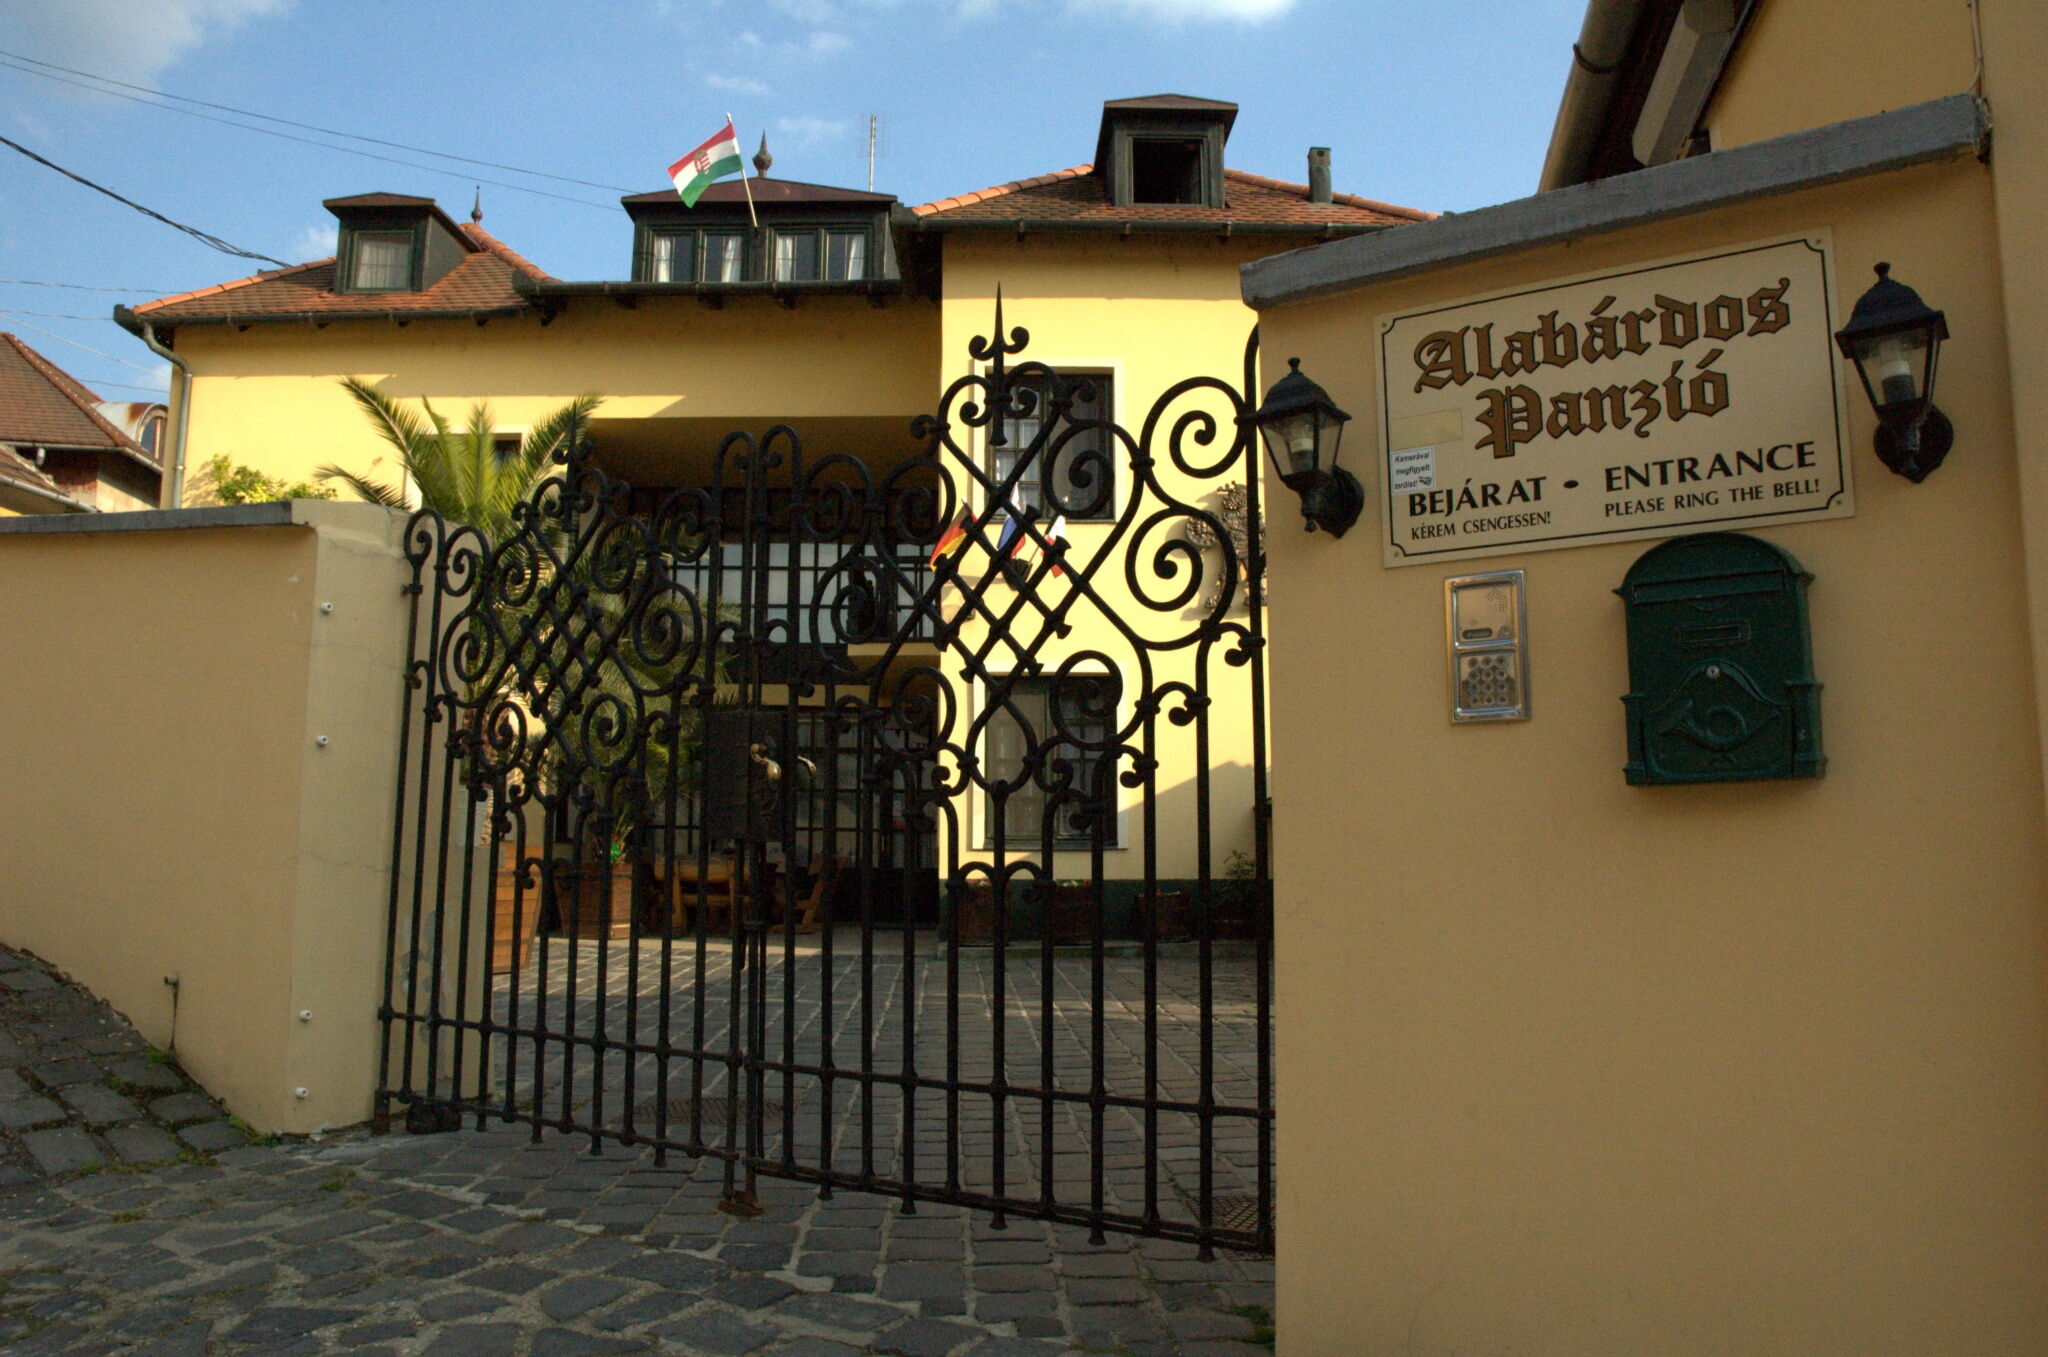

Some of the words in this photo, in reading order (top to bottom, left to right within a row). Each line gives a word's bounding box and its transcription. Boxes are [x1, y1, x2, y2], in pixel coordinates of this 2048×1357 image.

[1475, 348, 1730, 459] Panzió
[1408, 476, 1547, 517] BEJÁRAT
[1605, 440, 1816, 493] ENTRANCE
[1605, 496, 1665, 517] PLEASE
[1674, 490, 1719, 510] RING
[1728, 485, 1763, 503] THE
[1773, 478, 1820, 498] BELL!
[1411, 522, 1456, 540] KÉREM
[1462, 511, 1551, 534] CSENGESSEN!
